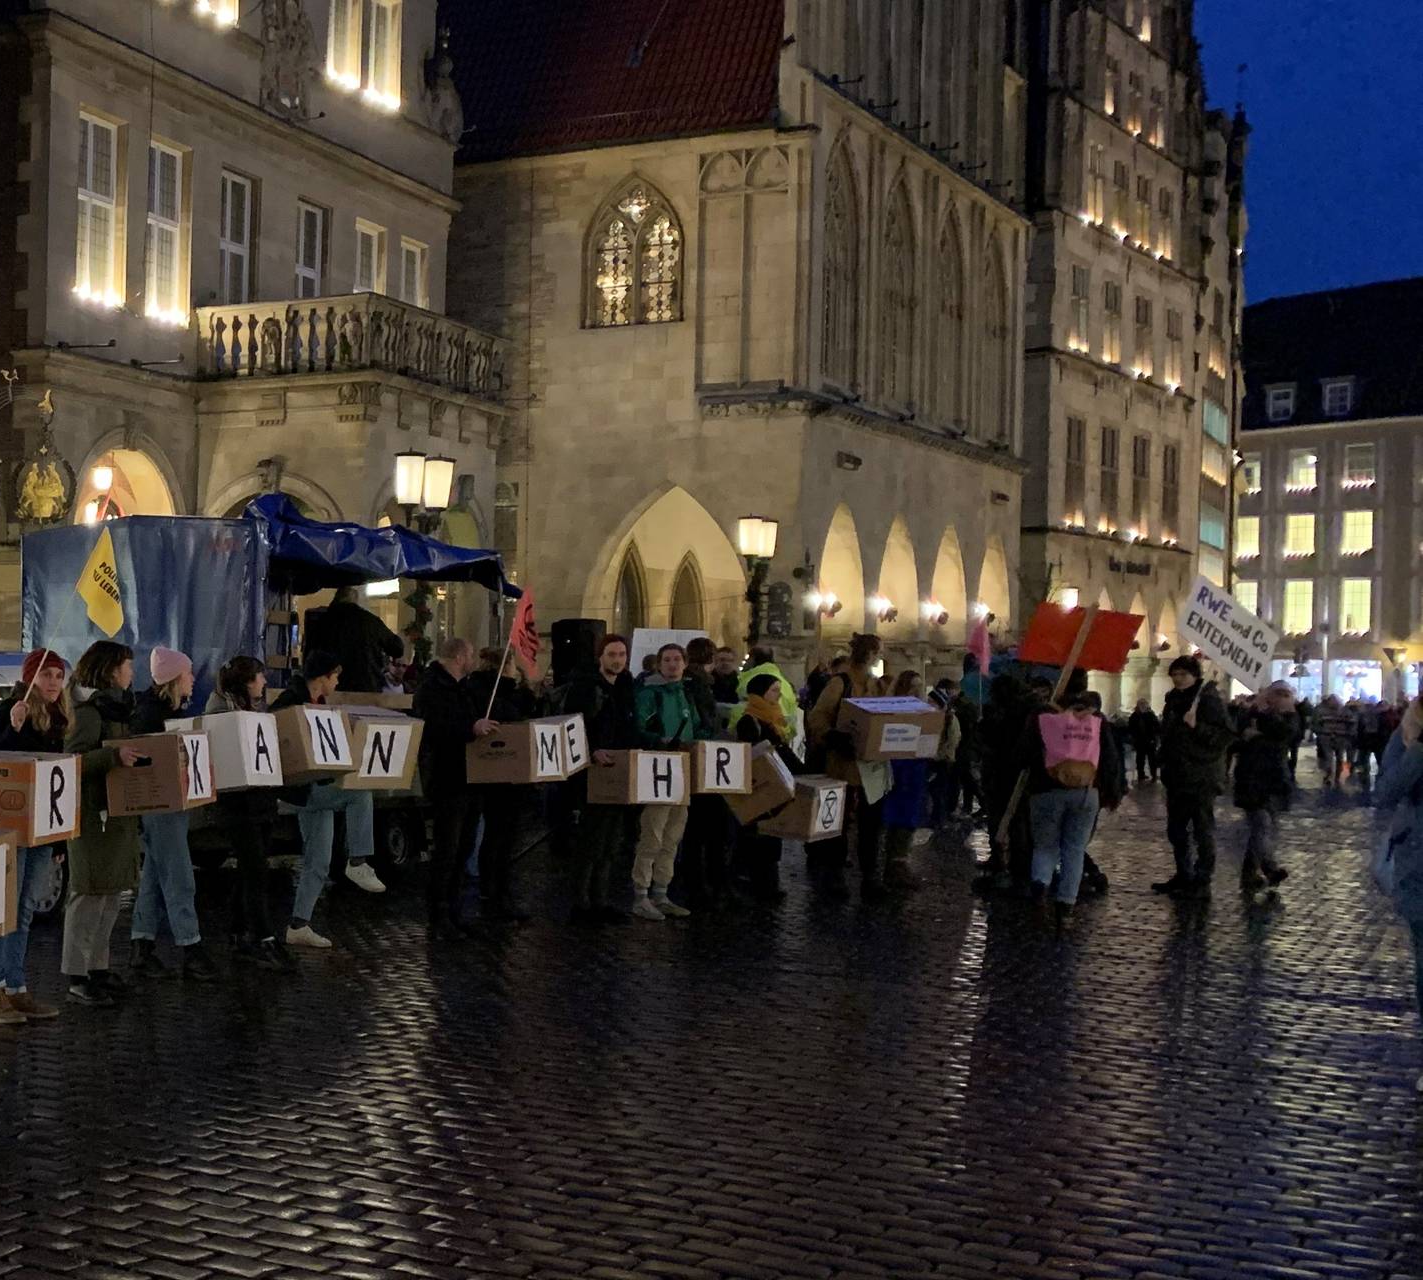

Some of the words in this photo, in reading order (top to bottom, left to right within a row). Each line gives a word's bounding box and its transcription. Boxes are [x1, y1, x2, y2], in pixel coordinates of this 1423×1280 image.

[1197, 585, 1233, 622] RWE
[1230, 619, 1253, 639] und
[190, 739, 204, 795] K
[255, 722, 273, 774] A
[315, 715, 340, 762] N
[367, 730, 396, 775] N
[652, 757, 673, 798] H
[715, 747, 731, 786] R
[49, 765, 65, 829] R
